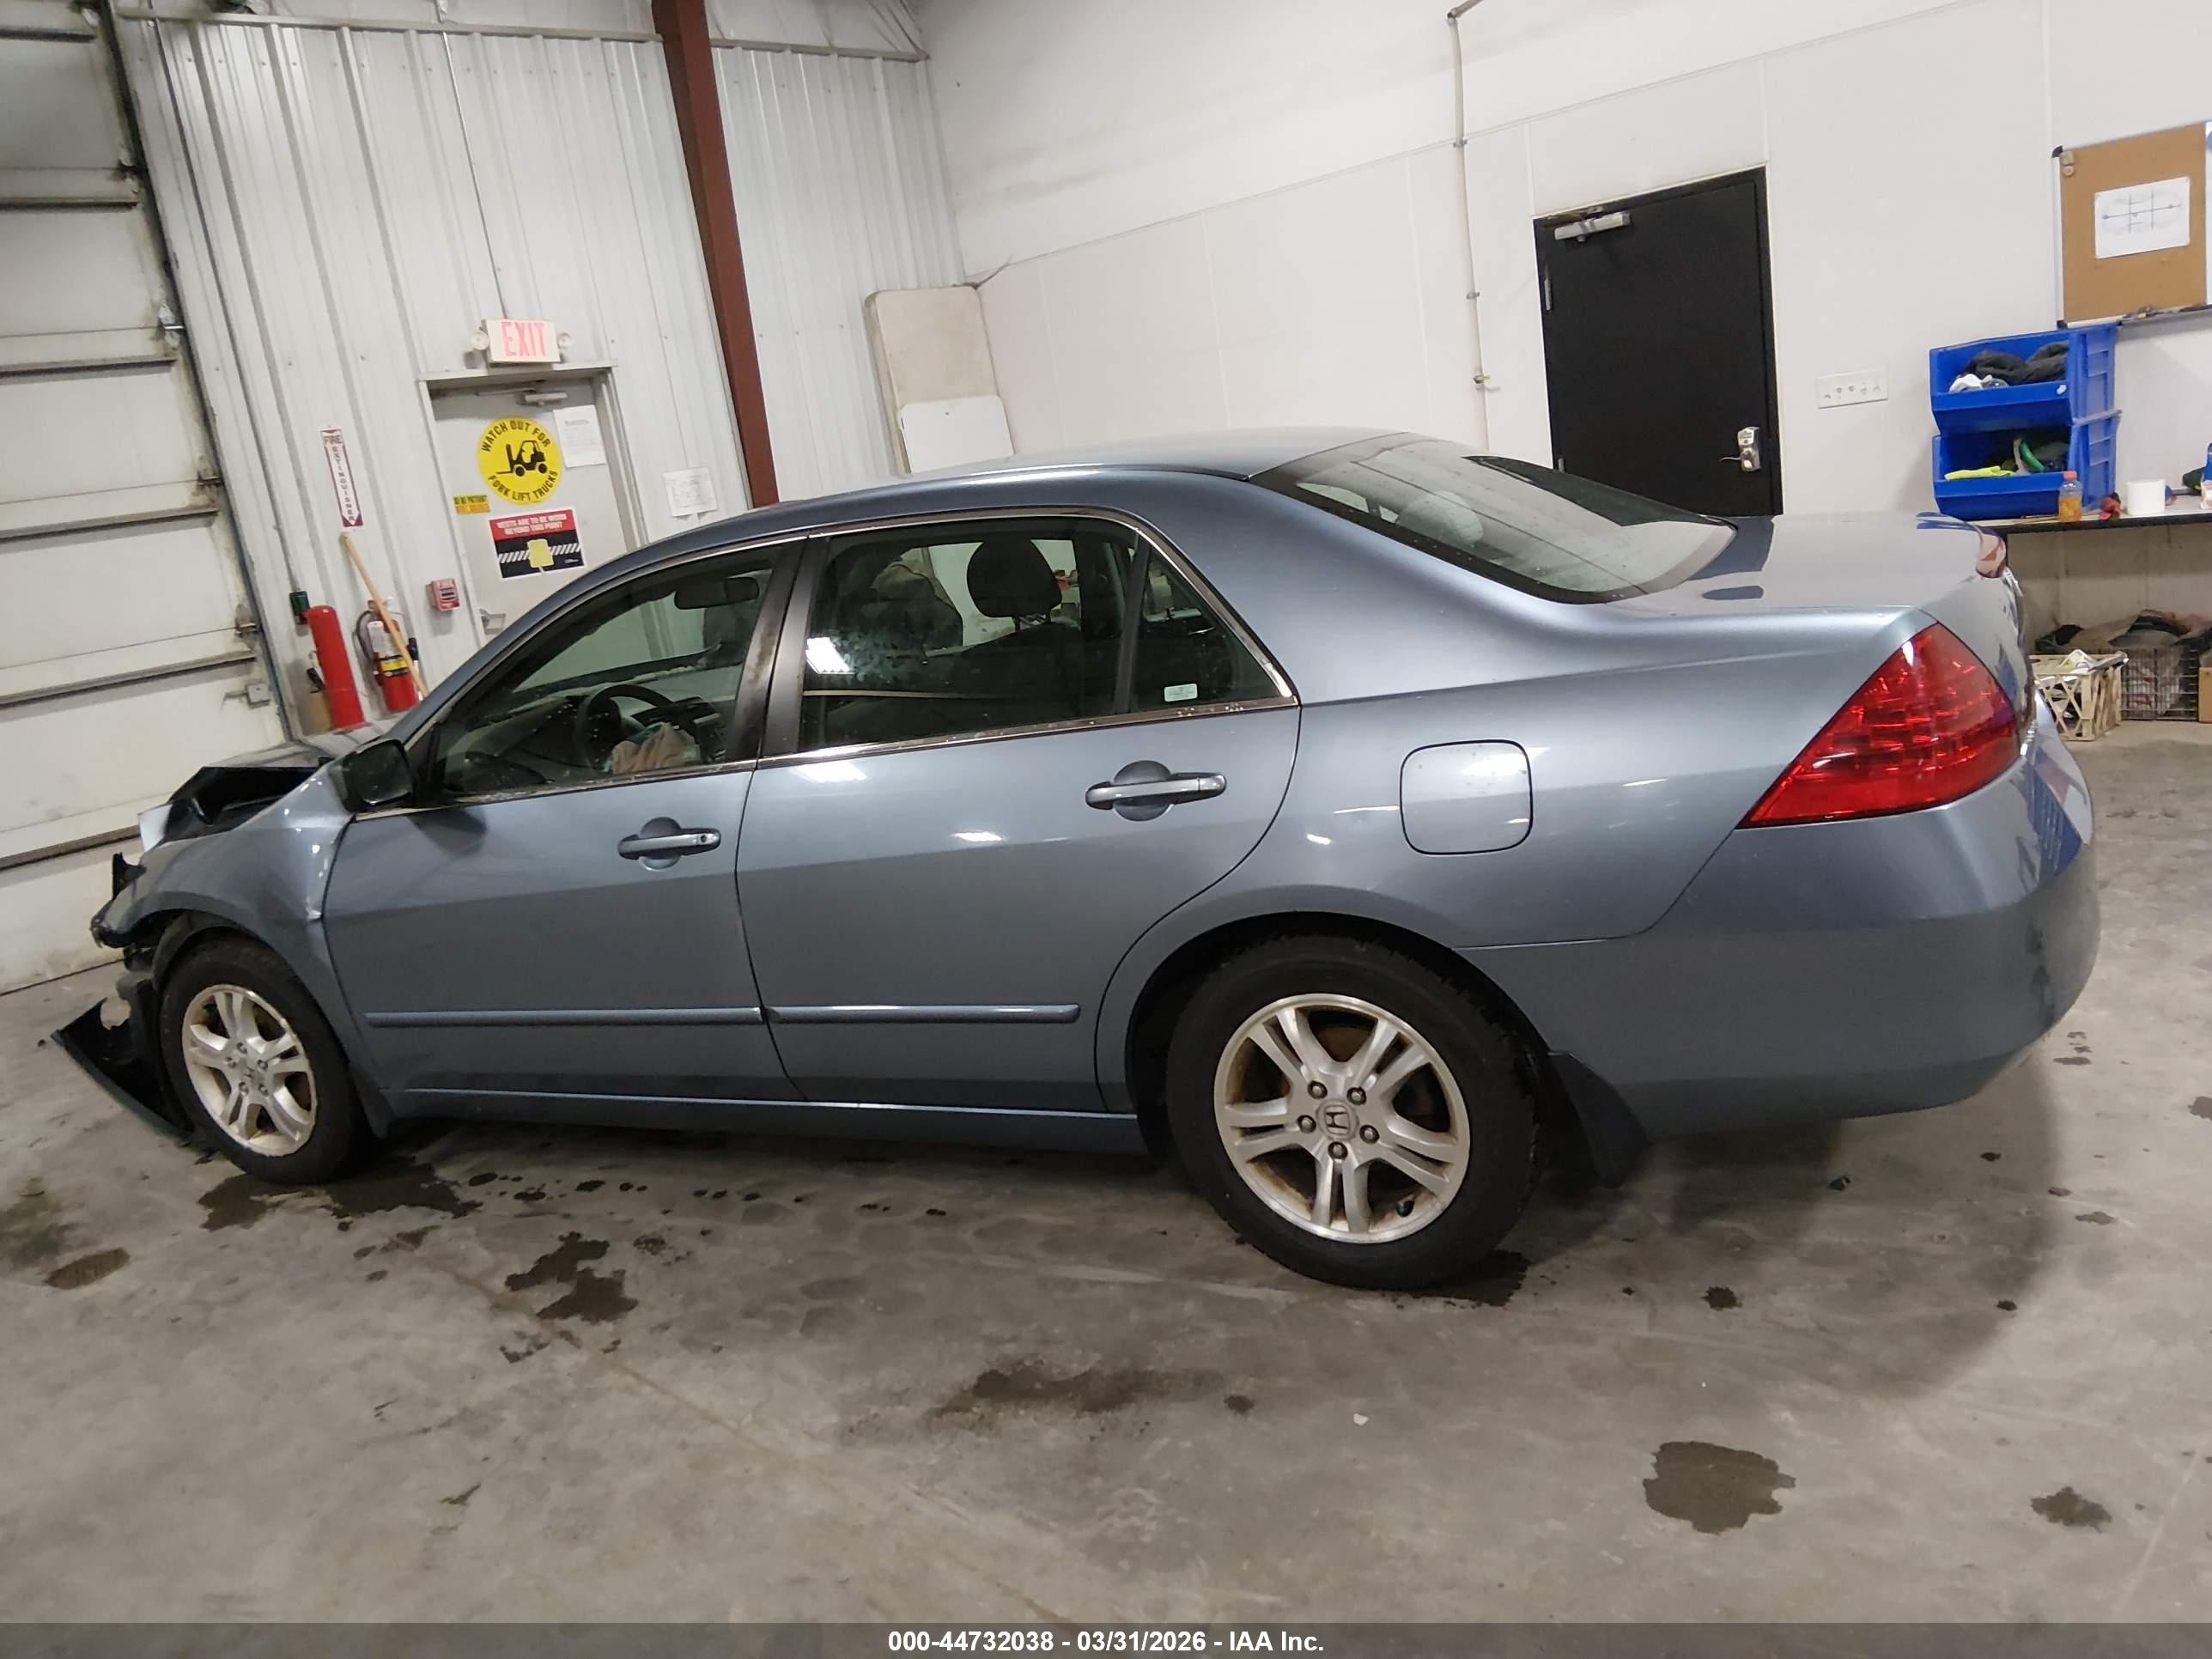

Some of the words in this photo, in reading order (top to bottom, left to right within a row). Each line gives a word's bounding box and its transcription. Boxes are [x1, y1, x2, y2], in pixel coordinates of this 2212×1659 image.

[501, 321, 546, 356] EXIT
[481, 422, 508, 452] WATCH
[510, 420, 531, 431] OUT
[532, 428, 551, 447] FOR
[488, 475, 511, 497] FORK
[512, 491, 531, 501] LIFT
[532, 470, 558, 499] TRUCKS
